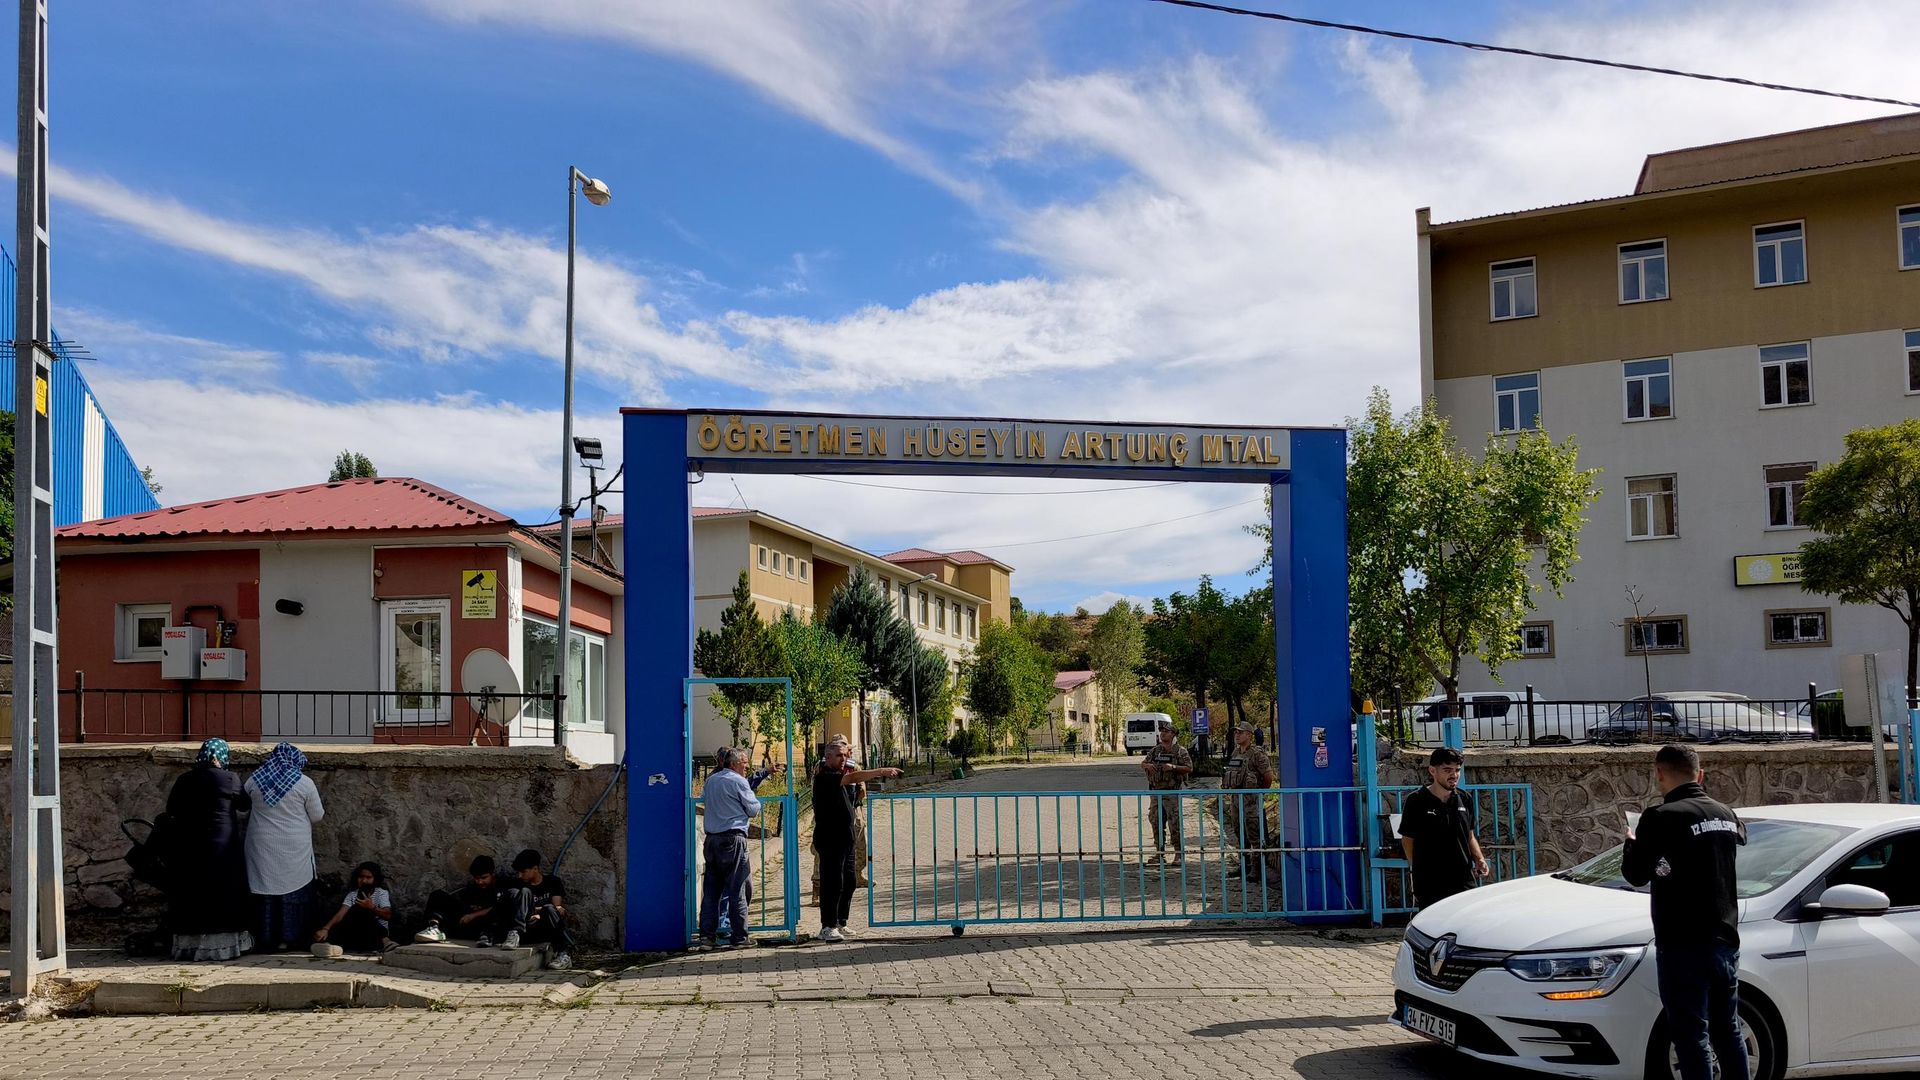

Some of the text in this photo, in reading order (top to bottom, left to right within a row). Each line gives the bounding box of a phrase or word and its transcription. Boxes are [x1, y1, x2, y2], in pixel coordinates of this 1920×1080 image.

[698, 415, 1281, 466] ÖĞRETMEN HÜSEYİN ARTUNÇ MTAL
[1195, 710, 1204, 723] P
[1690, 823, 1701, 836] 12
[1408, 1008, 1416, 1026] 34
[1438, 1019, 1453, 1041] 915
